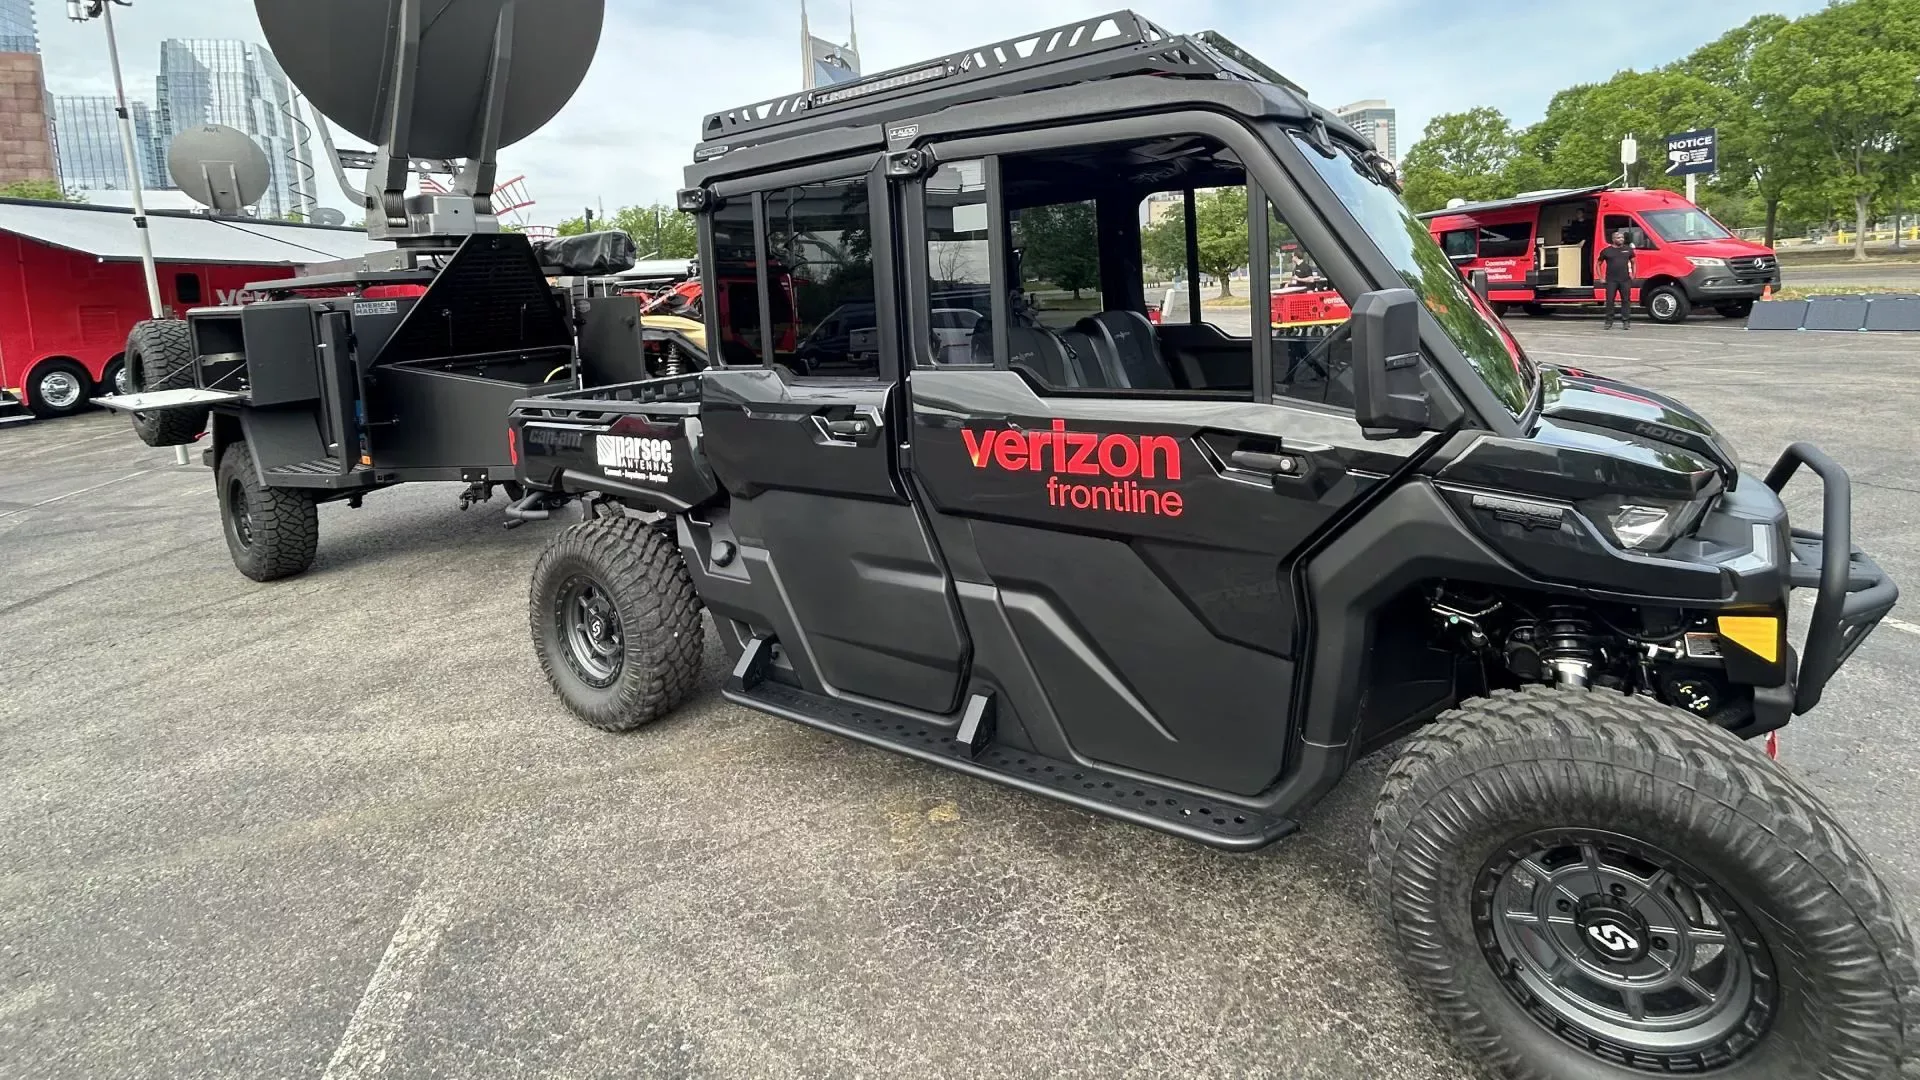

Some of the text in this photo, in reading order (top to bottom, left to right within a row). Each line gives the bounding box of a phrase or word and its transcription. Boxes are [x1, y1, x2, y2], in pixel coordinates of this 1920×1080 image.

[1669, 136, 1713, 150] NOTICE
[356, 301, 396, 309] AMERICAN
[529, 429, 582, 448] can-am
[1636, 423, 1689, 443] HD10
[615, 436, 672, 467] parsec
[961, 419, 1181, 480] verizon
[621, 458, 673, 473] ANTENNAS
[1047, 476, 1183, 517] frontline
[1473, 495, 1563, 518] DEFENDER
